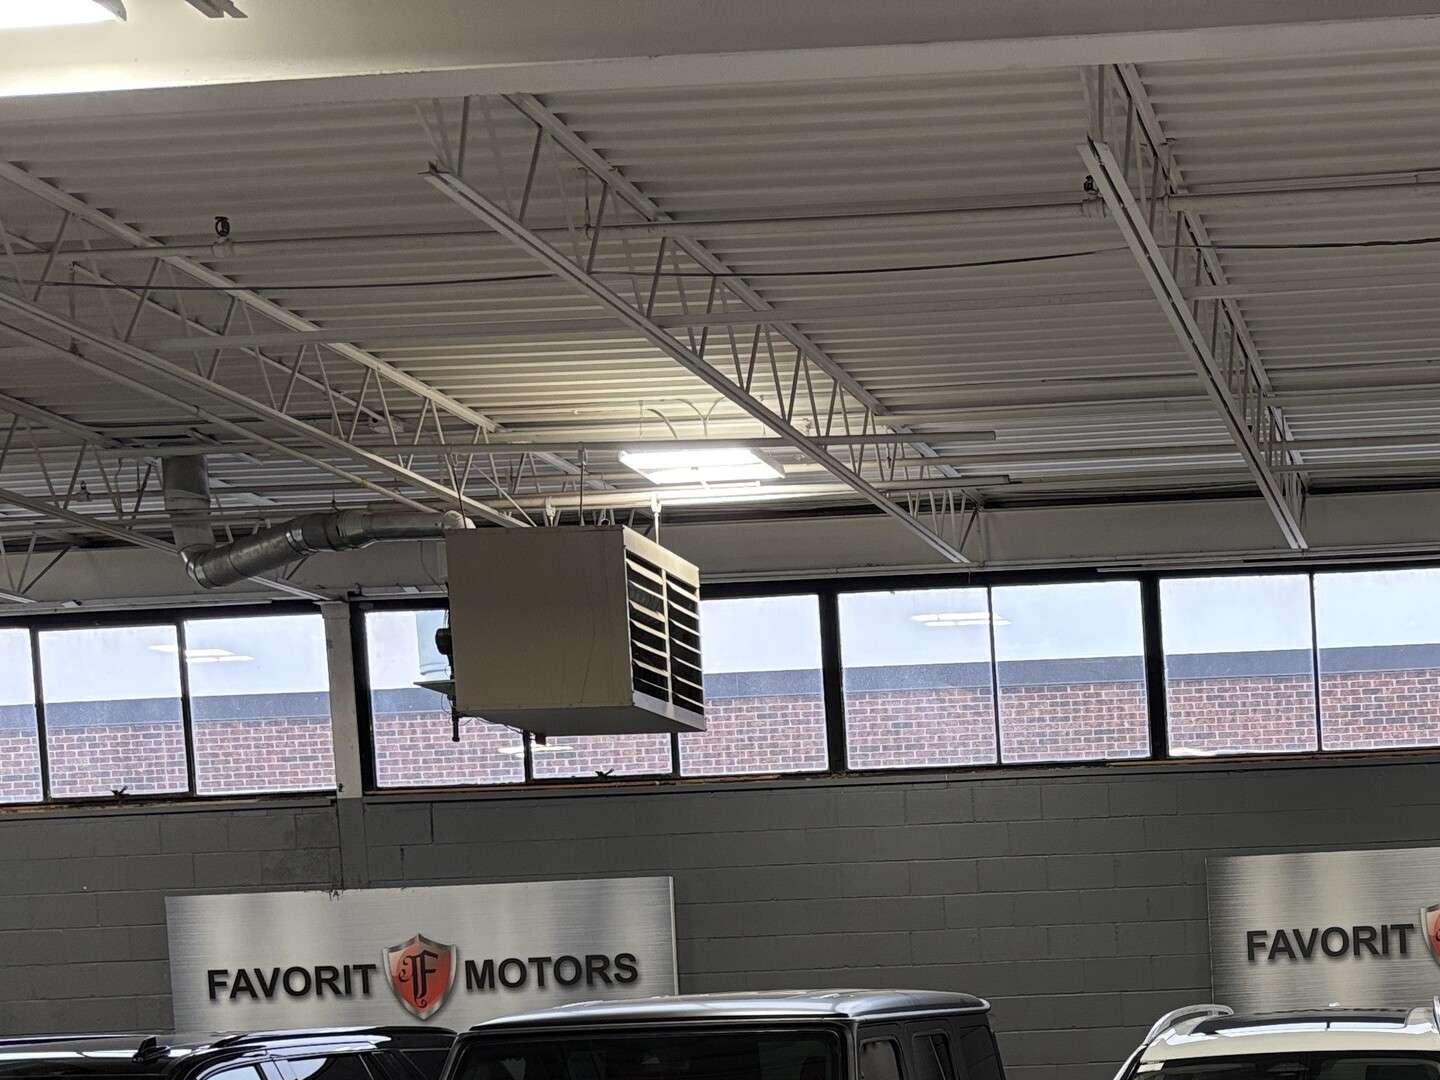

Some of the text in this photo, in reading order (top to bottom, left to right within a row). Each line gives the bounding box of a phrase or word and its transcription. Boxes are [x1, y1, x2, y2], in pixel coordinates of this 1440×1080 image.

[1246, 923, 1415, 961] FAVORIT
[207, 952, 639, 1000] FAVORIT MOTORS
